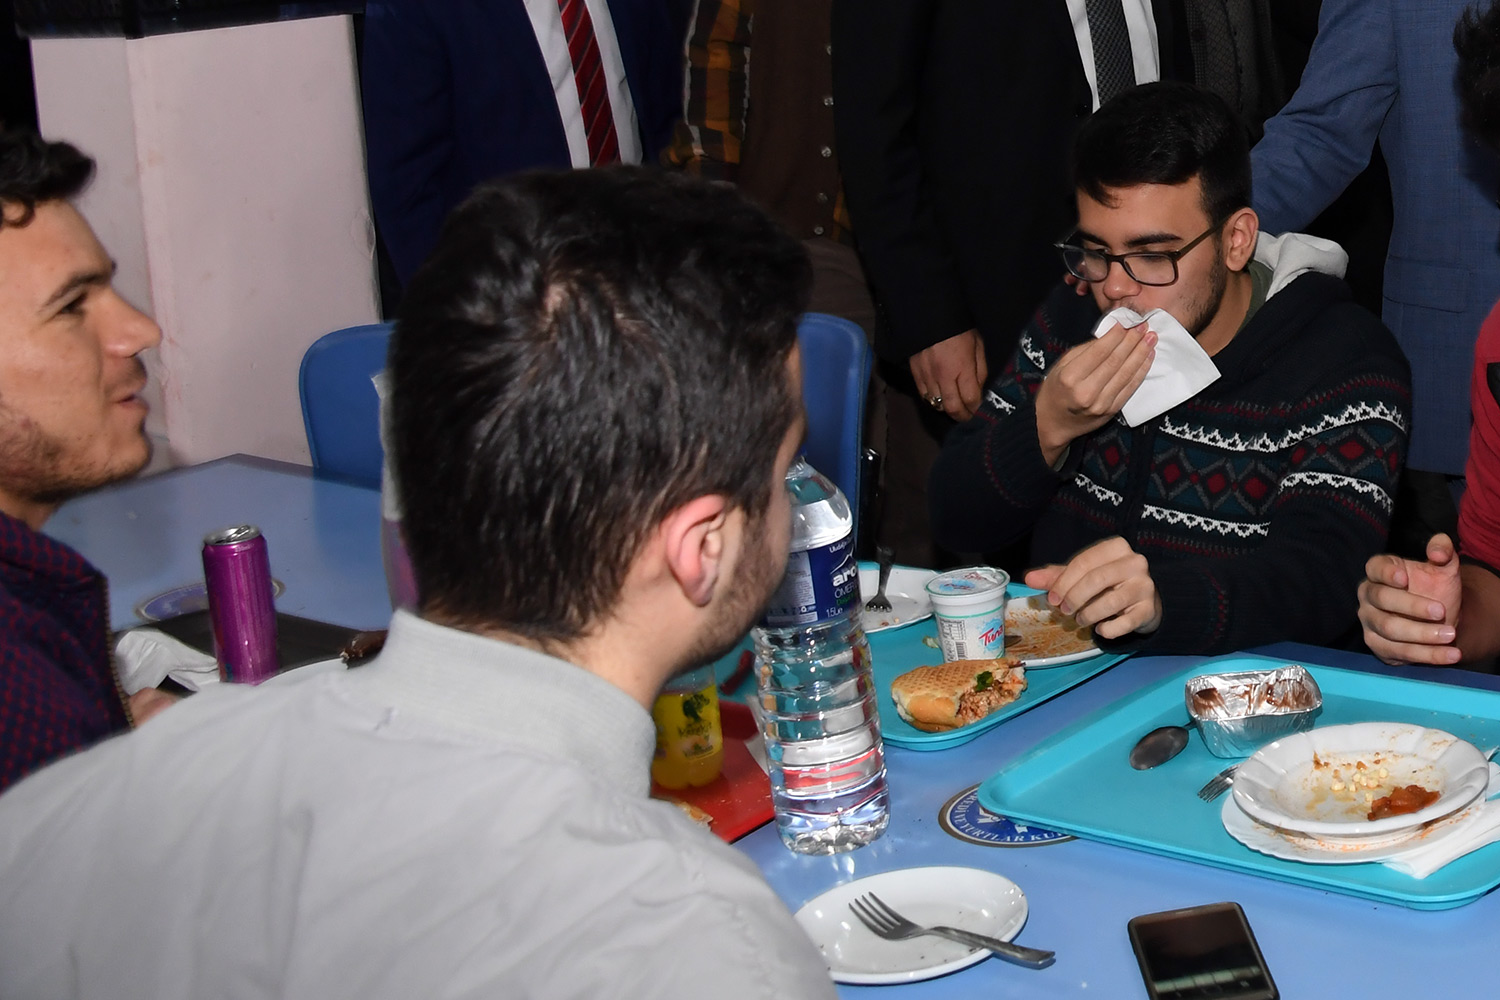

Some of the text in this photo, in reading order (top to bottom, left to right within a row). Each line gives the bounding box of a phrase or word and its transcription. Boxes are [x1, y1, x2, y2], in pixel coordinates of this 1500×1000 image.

[954, 791, 978, 813] REDİ
[959, 822, 1025, 842] YURTLAR
[1030, 831, 1062, 842] KU
